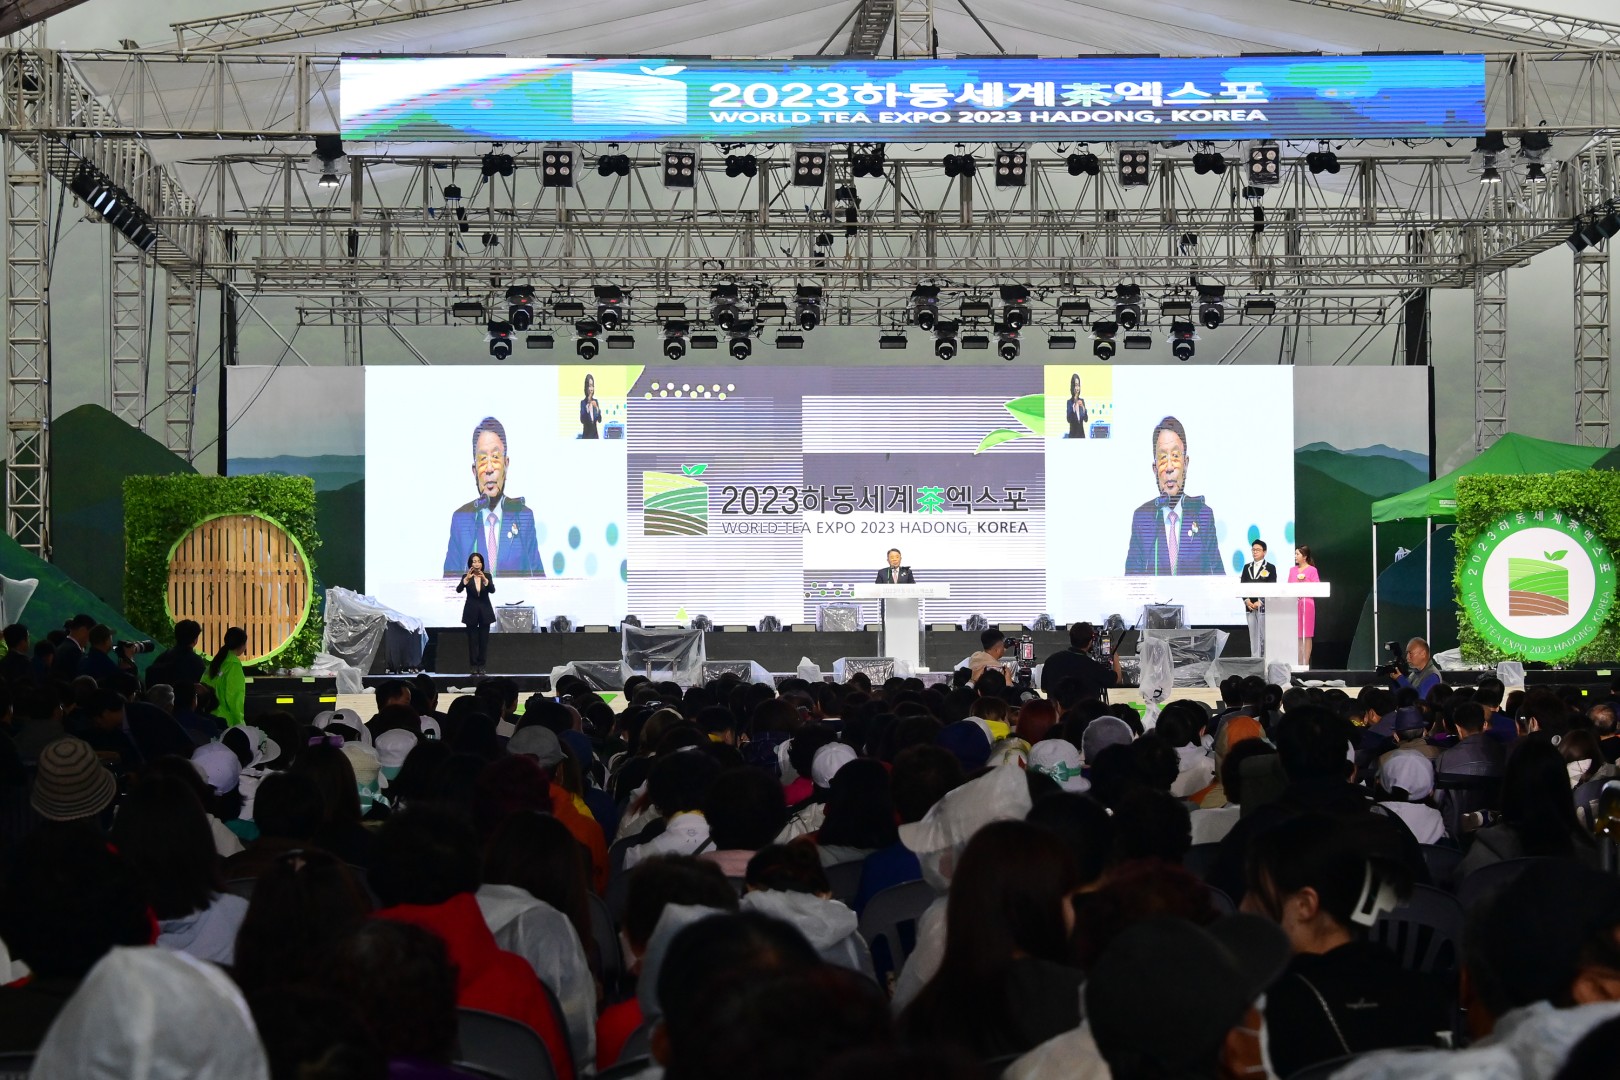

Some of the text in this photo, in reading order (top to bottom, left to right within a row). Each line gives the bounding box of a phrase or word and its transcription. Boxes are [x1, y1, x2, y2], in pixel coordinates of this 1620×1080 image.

[708, 82, 1270, 109] 2023하동세계茶엑스포
[708, 109, 1269, 124] WORLD TEA EXPO 2023 HADONG, KOREA
[721, 485, 1029, 515] 2023하동세계茶엑스포
[721, 521, 1029, 535] WORLD TEA EXPO 2023 HADONG, KOREA
[1468, 591, 1610, 654] WORLD TEA EXPO 2023 HADONG, KOREA
